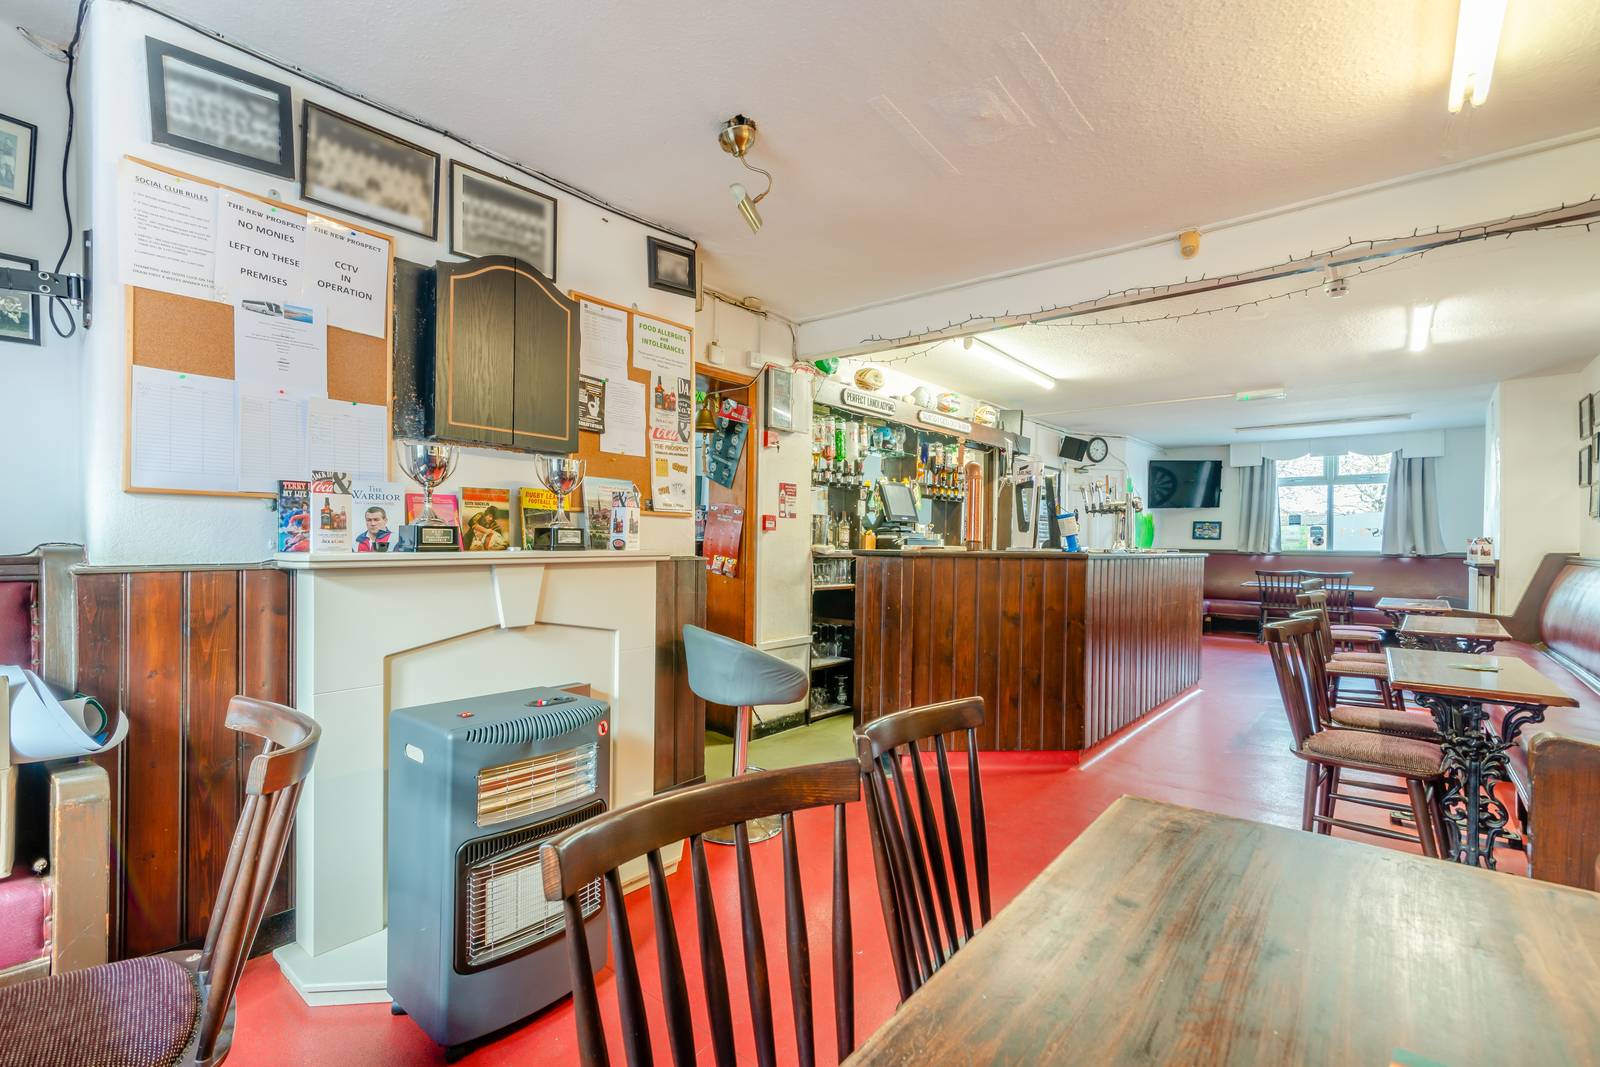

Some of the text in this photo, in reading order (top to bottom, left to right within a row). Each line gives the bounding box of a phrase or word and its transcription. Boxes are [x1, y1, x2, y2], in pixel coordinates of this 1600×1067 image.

[135, 176, 208, 202] SOCIAL CLUB RULES
[226, 201, 306, 232] THE NEW PROSPECT
[237, 219, 295, 243] NO MONIES
[314, 226, 382, 253] THE NEW PROSPECT
[229, 240, 300, 268] LEFT ON THESE
[334, 261, 359, 273] CCTV
[240, 268, 288, 287] PREMISES
[341, 275, 351, 284] IN
[317, 279, 373, 301] OPERATION
[639, 322, 687, 342] FOOD ALLERGIES
[641, 337, 685, 355] INTOLERANCES
[846, 391, 866, 405] PERFECT
[283, 481, 307, 490] TERRY
[312, 481, 333, 493] Coca
[526, 491, 544, 499] RUGBY
